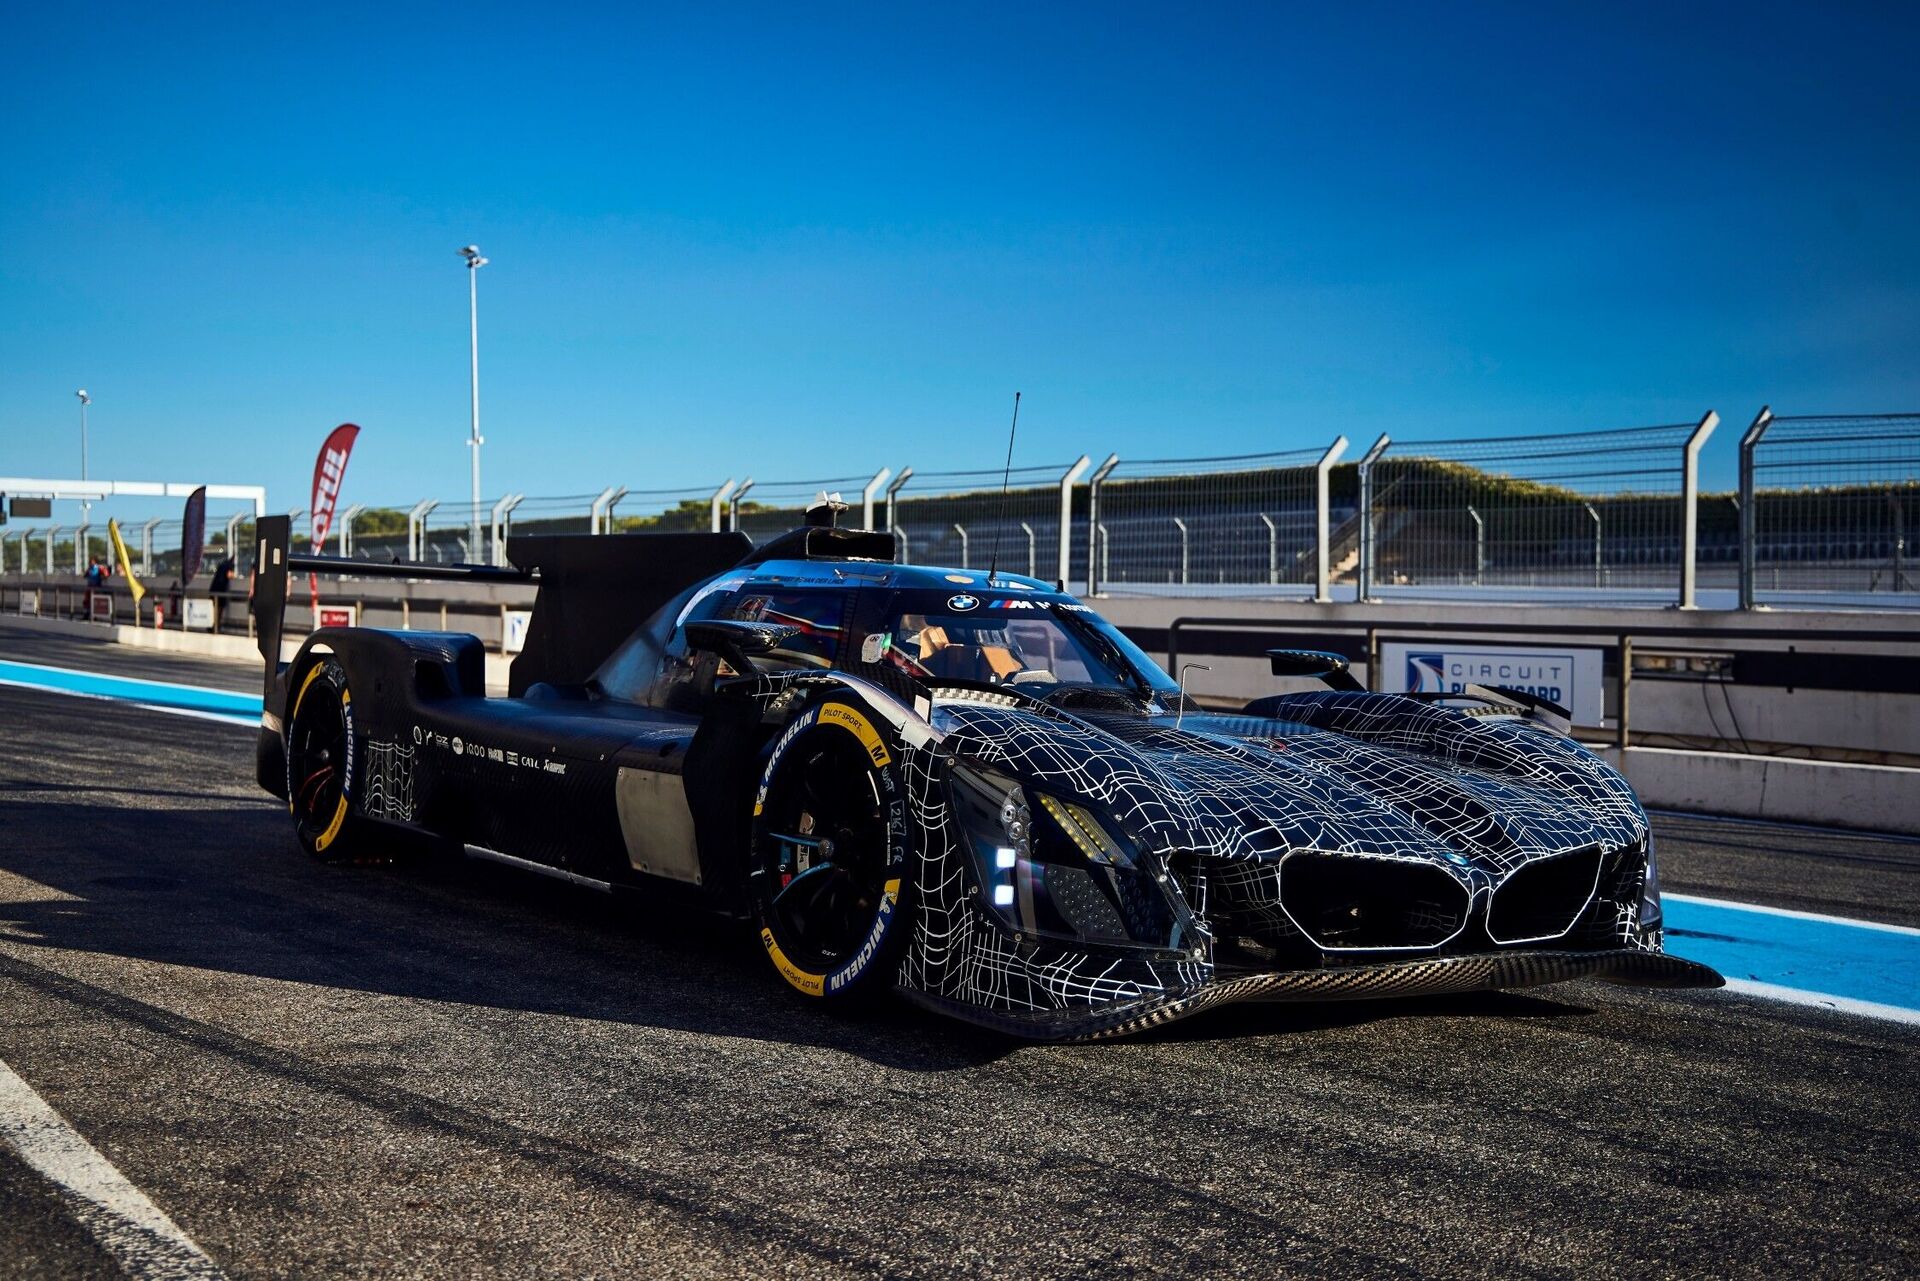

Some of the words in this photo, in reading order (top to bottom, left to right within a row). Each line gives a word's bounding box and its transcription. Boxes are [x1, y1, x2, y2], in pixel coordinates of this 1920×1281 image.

[1451, 664, 1561, 680] CIRCUIT
[436, 735, 448, 745] OZ
[823, 709, 841, 718] PILOT
[841, 712, 863, 730] SPORT
[871, 745, 886, 762] M
[345, 716, 354, 791] MICHELIN
[466, 743, 486, 757] iQOO
[765, 710, 814, 783] MICHELIN
[892, 846, 904, 865] FR
[831, 916, 885, 990] MICHELIN
[783, 965, 802, 984] SPORT
[801, 979, 819, 990] PILOT
